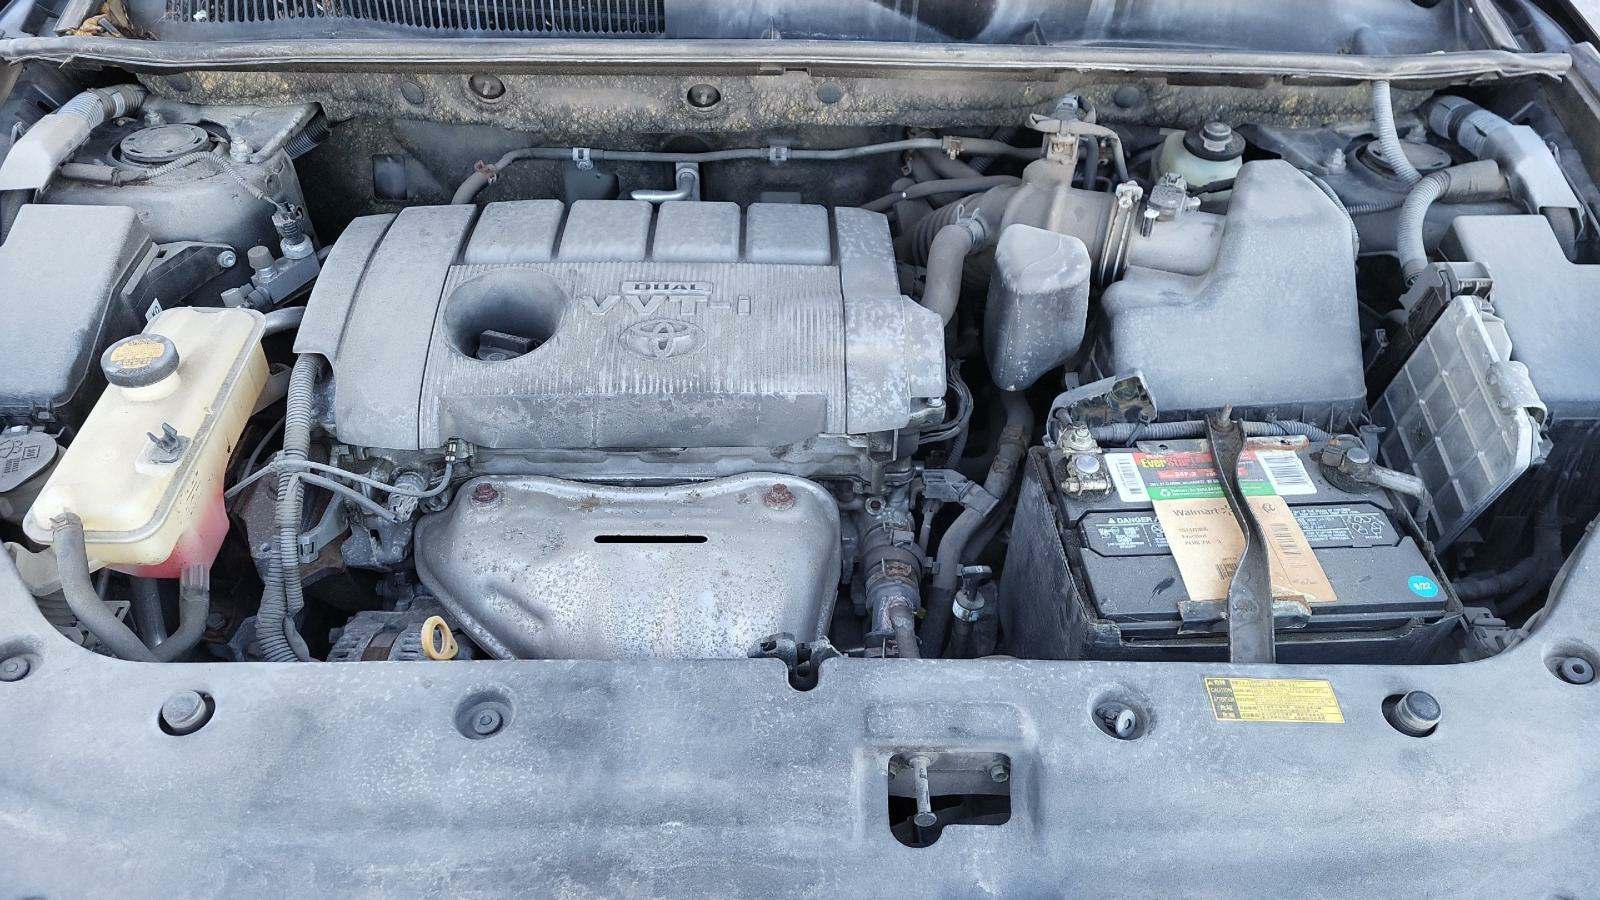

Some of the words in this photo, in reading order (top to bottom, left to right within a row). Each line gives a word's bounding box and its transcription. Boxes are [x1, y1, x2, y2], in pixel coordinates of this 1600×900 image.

[633, 282, 705, 292] DUAL
[580, 294, 752, 316] VVT-i
[1173, 508, 1219, 517] Walmart
[1116, 516, 1153, 524] DANGER
